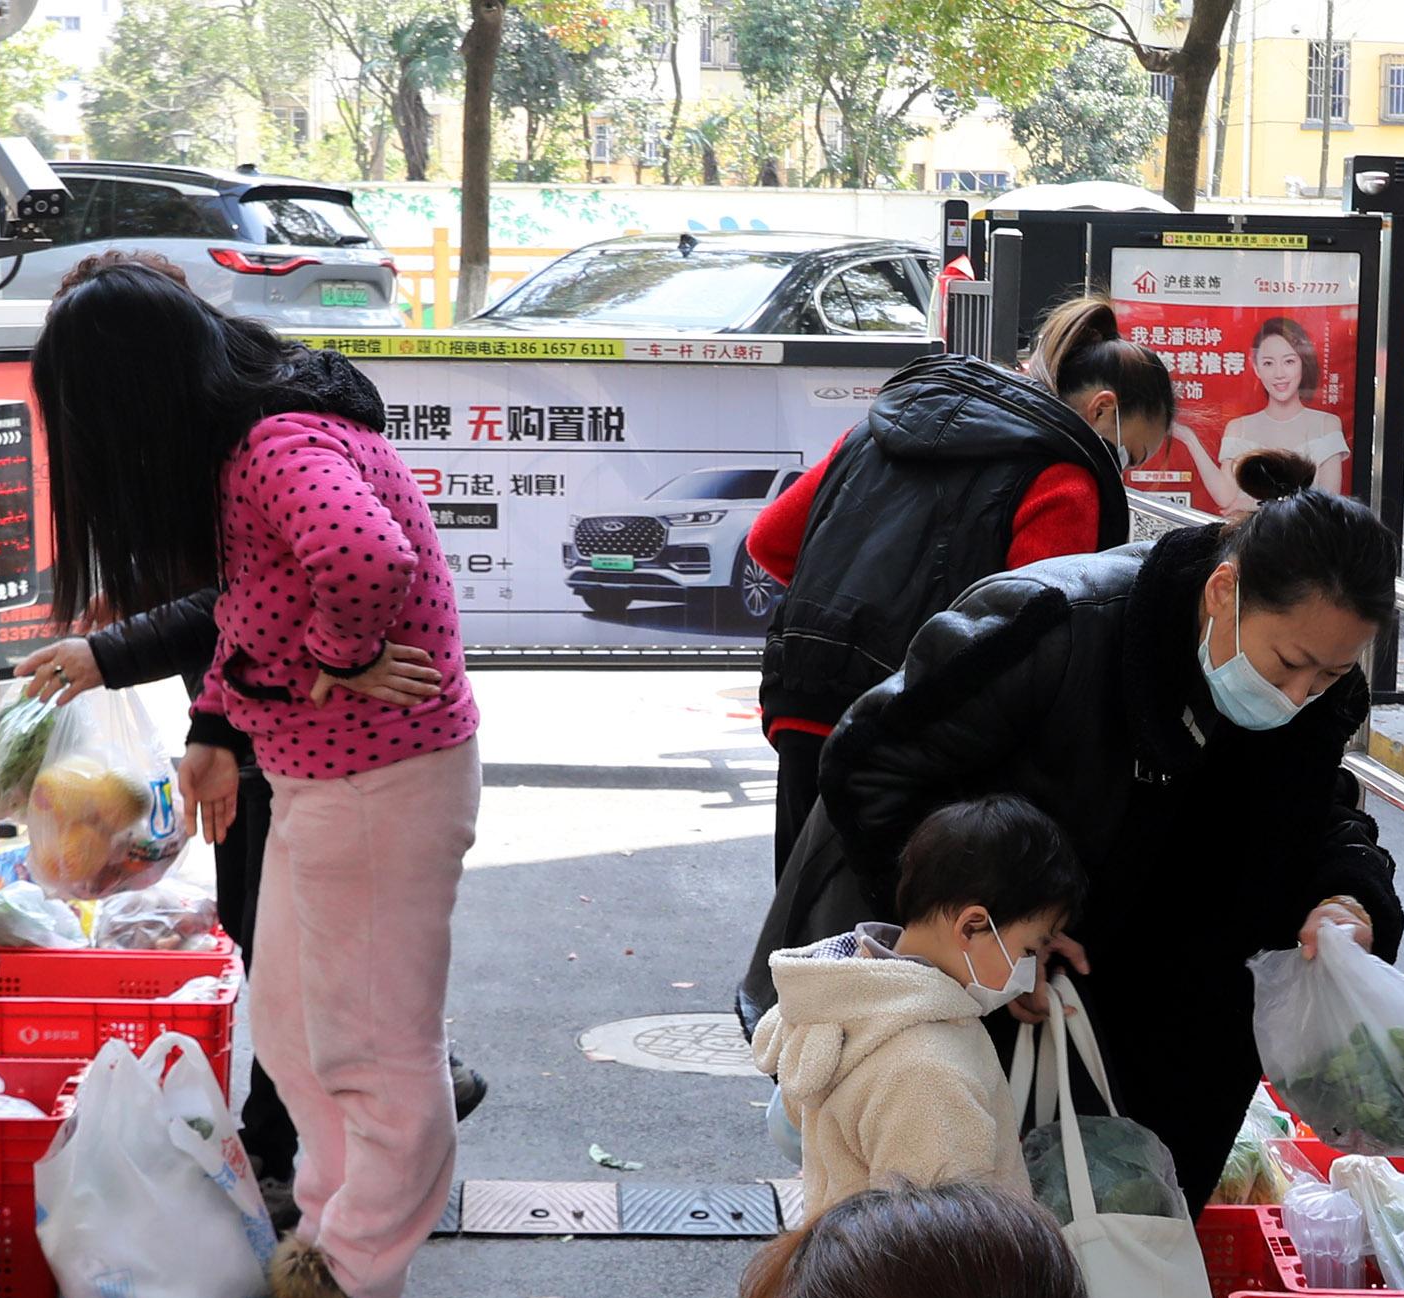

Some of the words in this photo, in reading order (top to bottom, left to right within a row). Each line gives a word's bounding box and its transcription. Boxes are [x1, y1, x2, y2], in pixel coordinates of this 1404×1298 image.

[1163, 275, 1222, 289] 沪佳装饰
[1272, 281, 1340, 294] 315-77777
[1131, 326, 1222, 346] 我是潘晓婷
[449, 341, 536, 355] 招商电话:186
[542, 343, 576, 355] 1657
[581, 343, 615, 356] 6111
[633, 344, 693, 359] 一车一杆
[703, 345, 763, 360] 行人绕行
[468, 406, 625, 442] 无购置税
